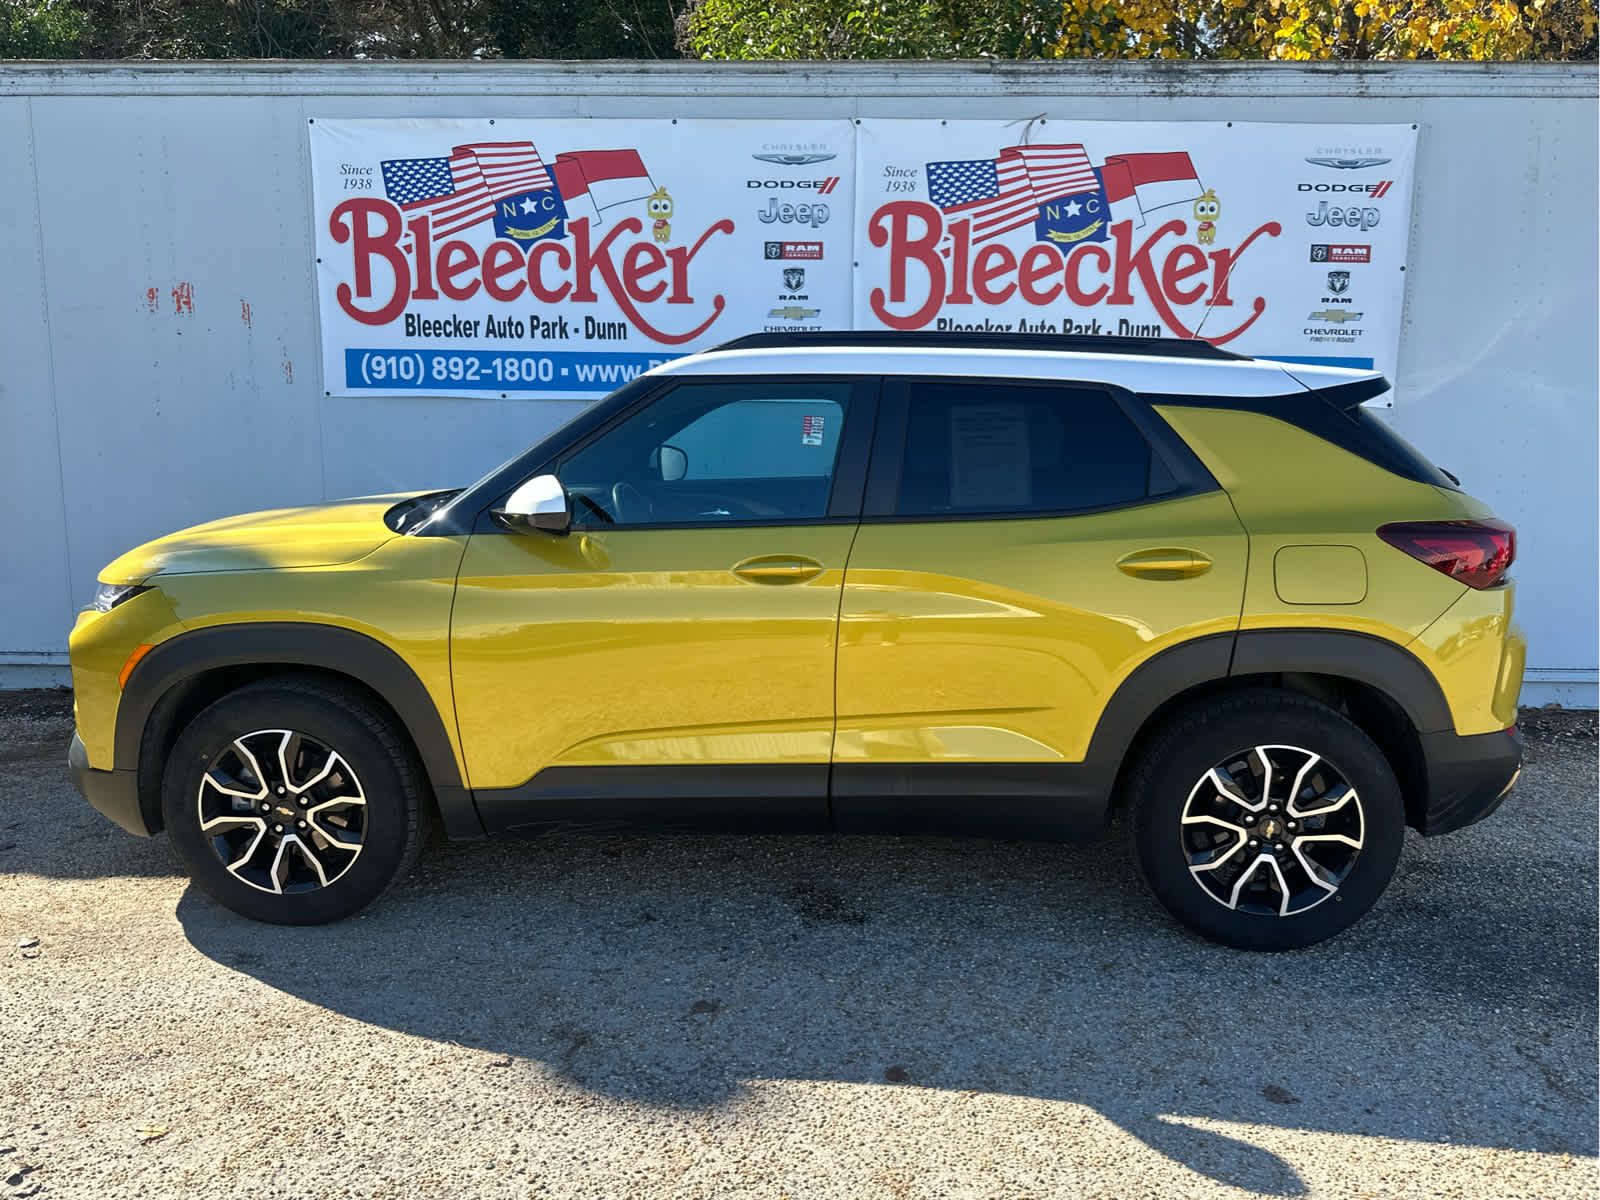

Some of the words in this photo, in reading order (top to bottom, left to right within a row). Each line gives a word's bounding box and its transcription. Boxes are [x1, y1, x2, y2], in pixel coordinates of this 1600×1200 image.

[340, 163, 373, 176] Since
[883, 165, 918, 178] Since
[343, 178, 373, 190] 1938
[747, 180, 826, 189] DODGE
[886, 180, 917, 193] 1938
[1297, 183, 1380, 192] DODGE
[502, 202, 517, 218] N
[541, 196, 556, 210] C
[758, 197, 830, 229] Jeep
[1046, 205, 1060, 220] N
[1086, 199, 1100, 213] C
[1305, 200, 1381, 231] Jeep
[330, 197, 735, 345] Bleecker
[869, 200, 1282, 346] Bleecker
[404, 313, 480, 338] Bleecker
[485, 314, 525, 339] Auto
[530, 315, 569, 340] Park
[584, 316, 628, 340] Dunn
[1303, 328, 1364, 336] CHEVROLET
[361, 353, 425, 385] (910)
[431, 356, 554, 382] 892-1800
